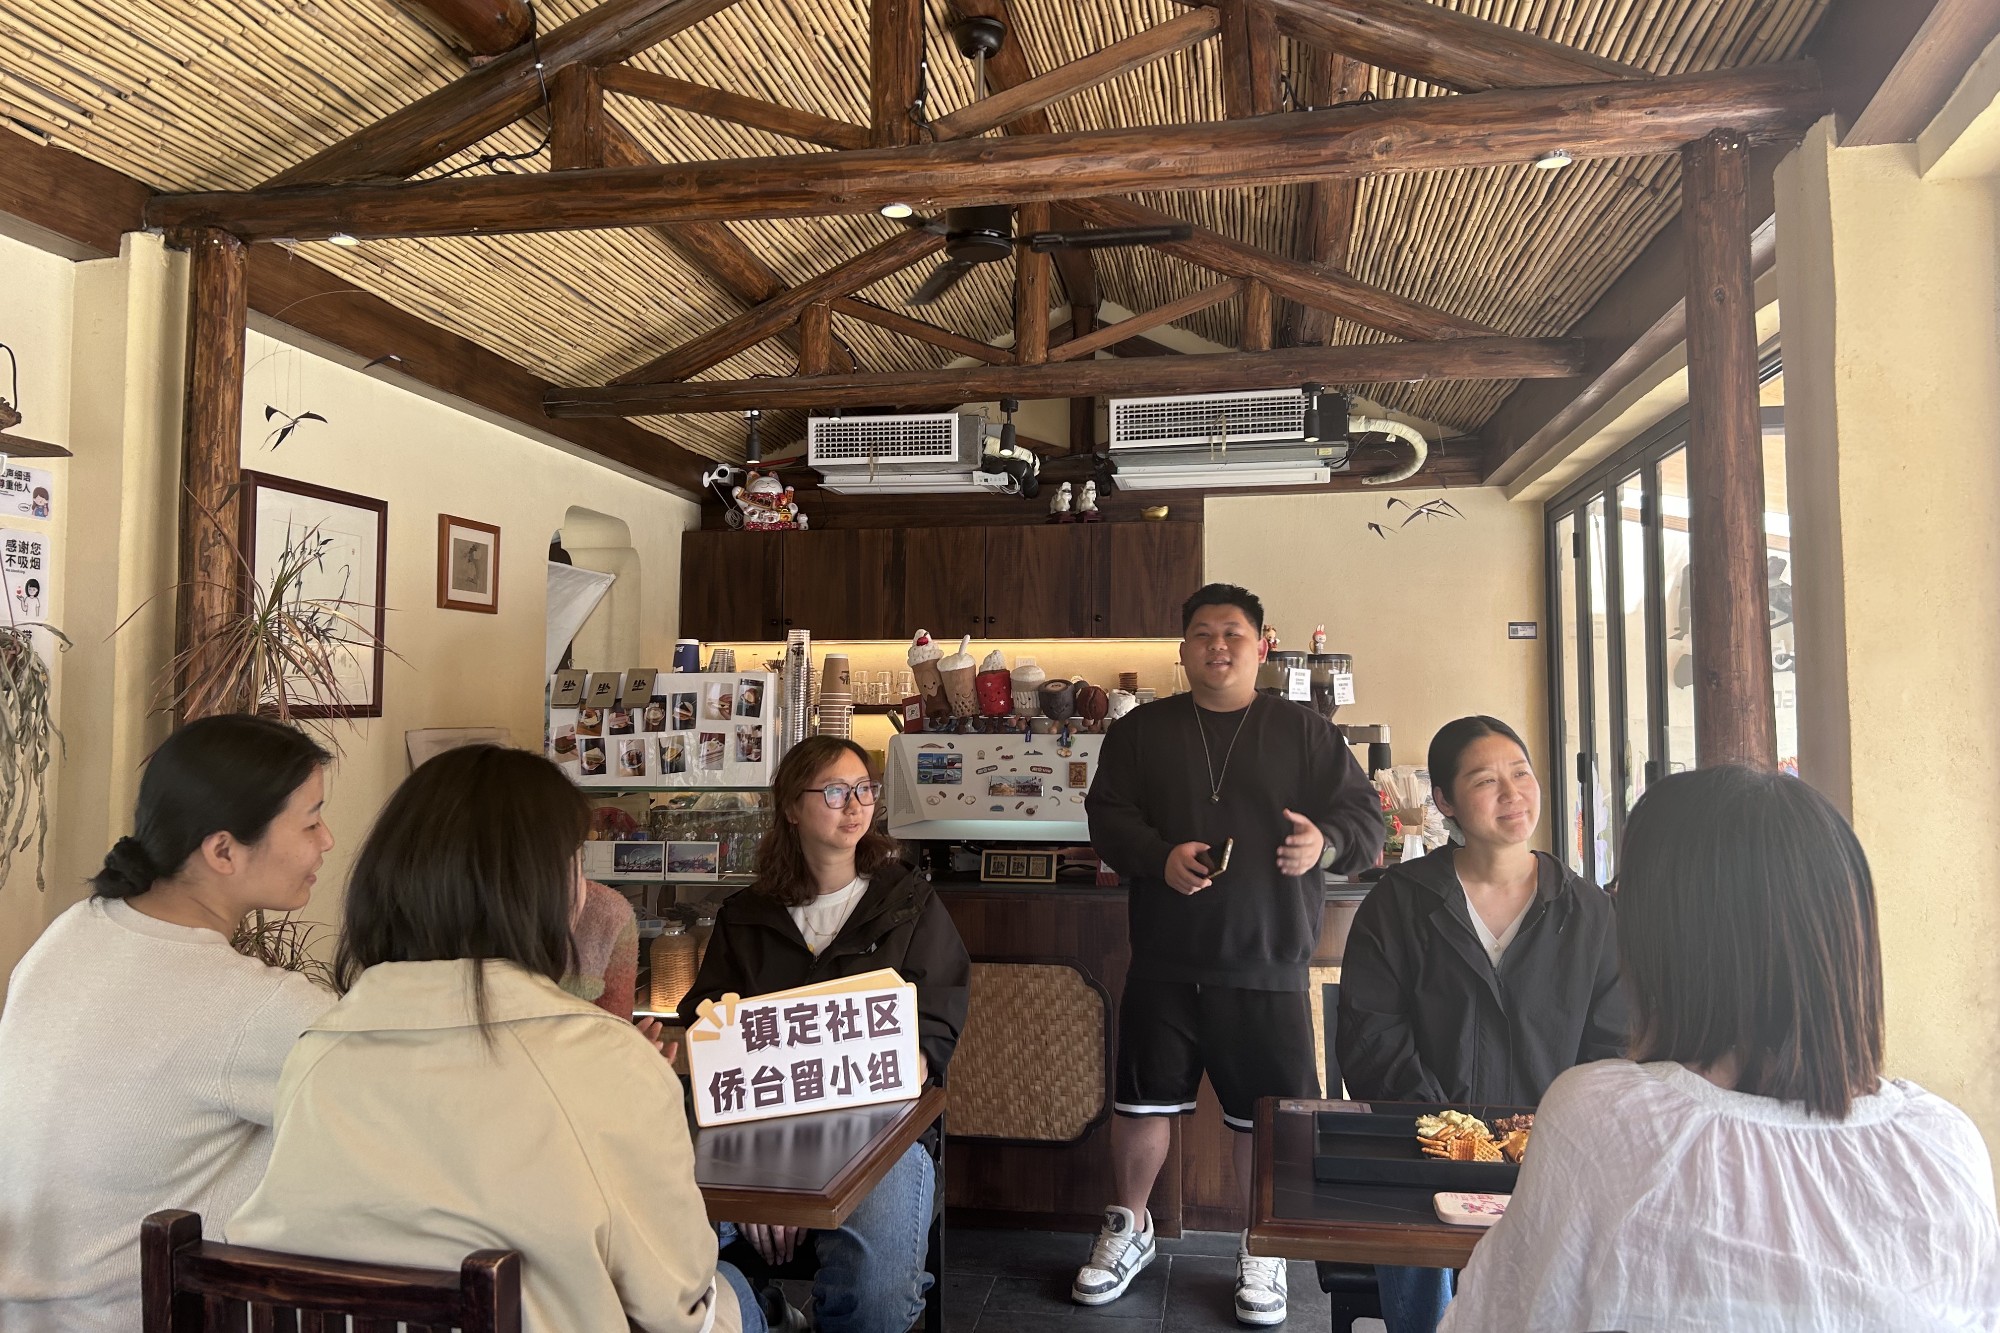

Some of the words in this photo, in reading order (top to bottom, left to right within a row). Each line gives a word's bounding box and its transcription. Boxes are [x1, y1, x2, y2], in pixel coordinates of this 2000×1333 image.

[5, 539, 41, 556] 感谢您
[5, 554, 41, 570] 不吸烟
[739, 993, 902, 1053] 镇定社区
[708, 1049, 904, 1114] 侨台留小组
